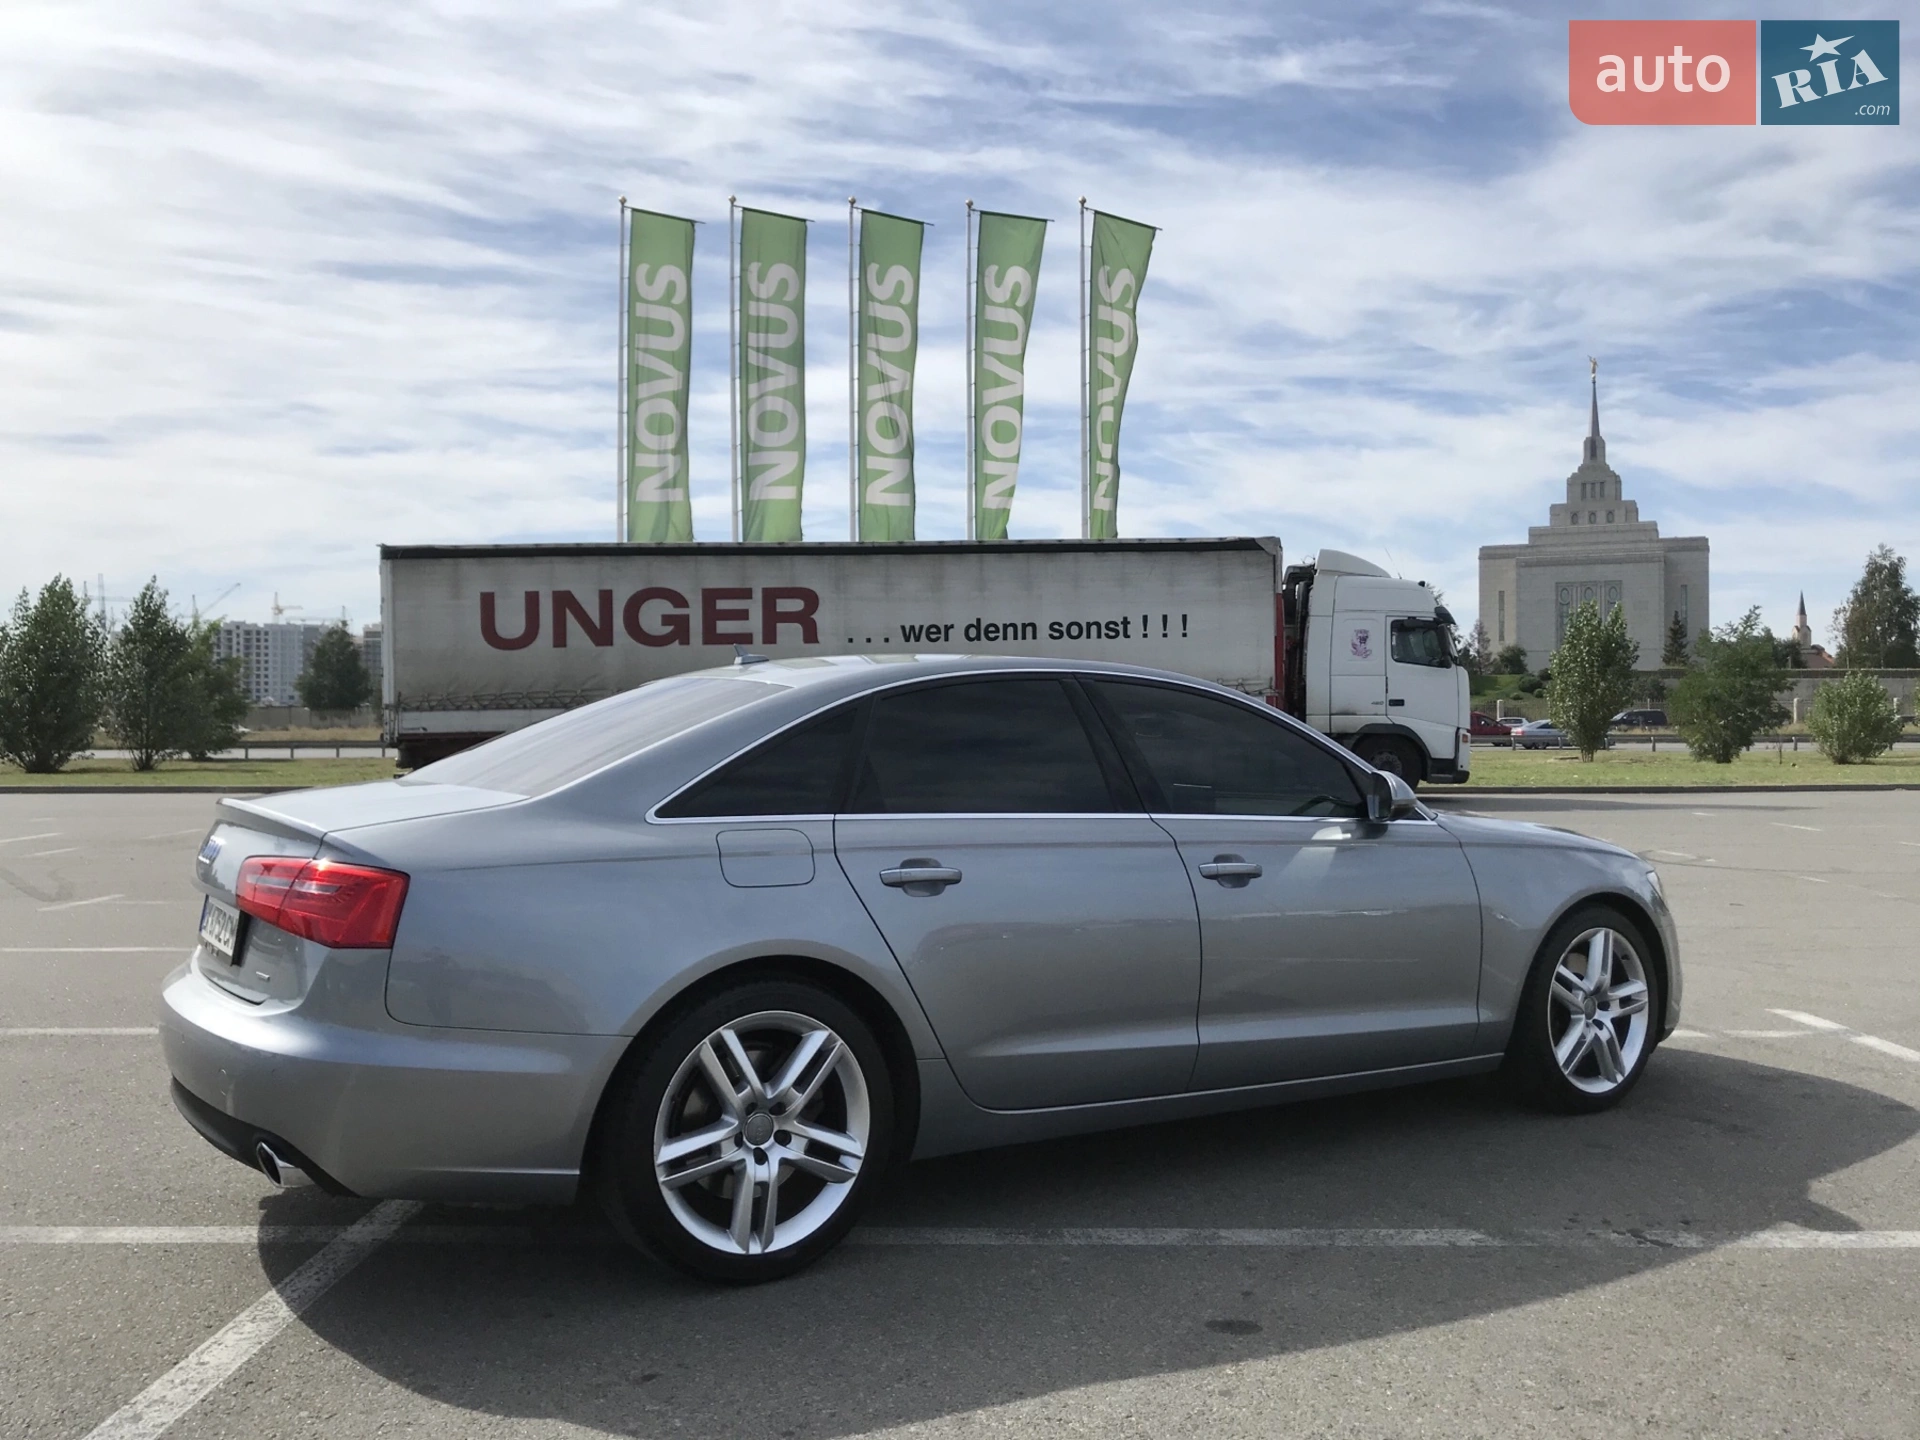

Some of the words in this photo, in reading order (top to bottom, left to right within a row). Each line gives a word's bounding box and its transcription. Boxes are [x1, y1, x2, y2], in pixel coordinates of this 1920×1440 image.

[634, 263, 688, 503] NOVUS
[747, 262, 800, 501] NOVUS
[866, 263, 915, 507] NOVUS
[982, 265, 1031, 509] NOVUS
[480, 587, 820, 650] UNGER
[963, 617, 1038, 642] denn
[1048, 615, 1131, 640] sonst
